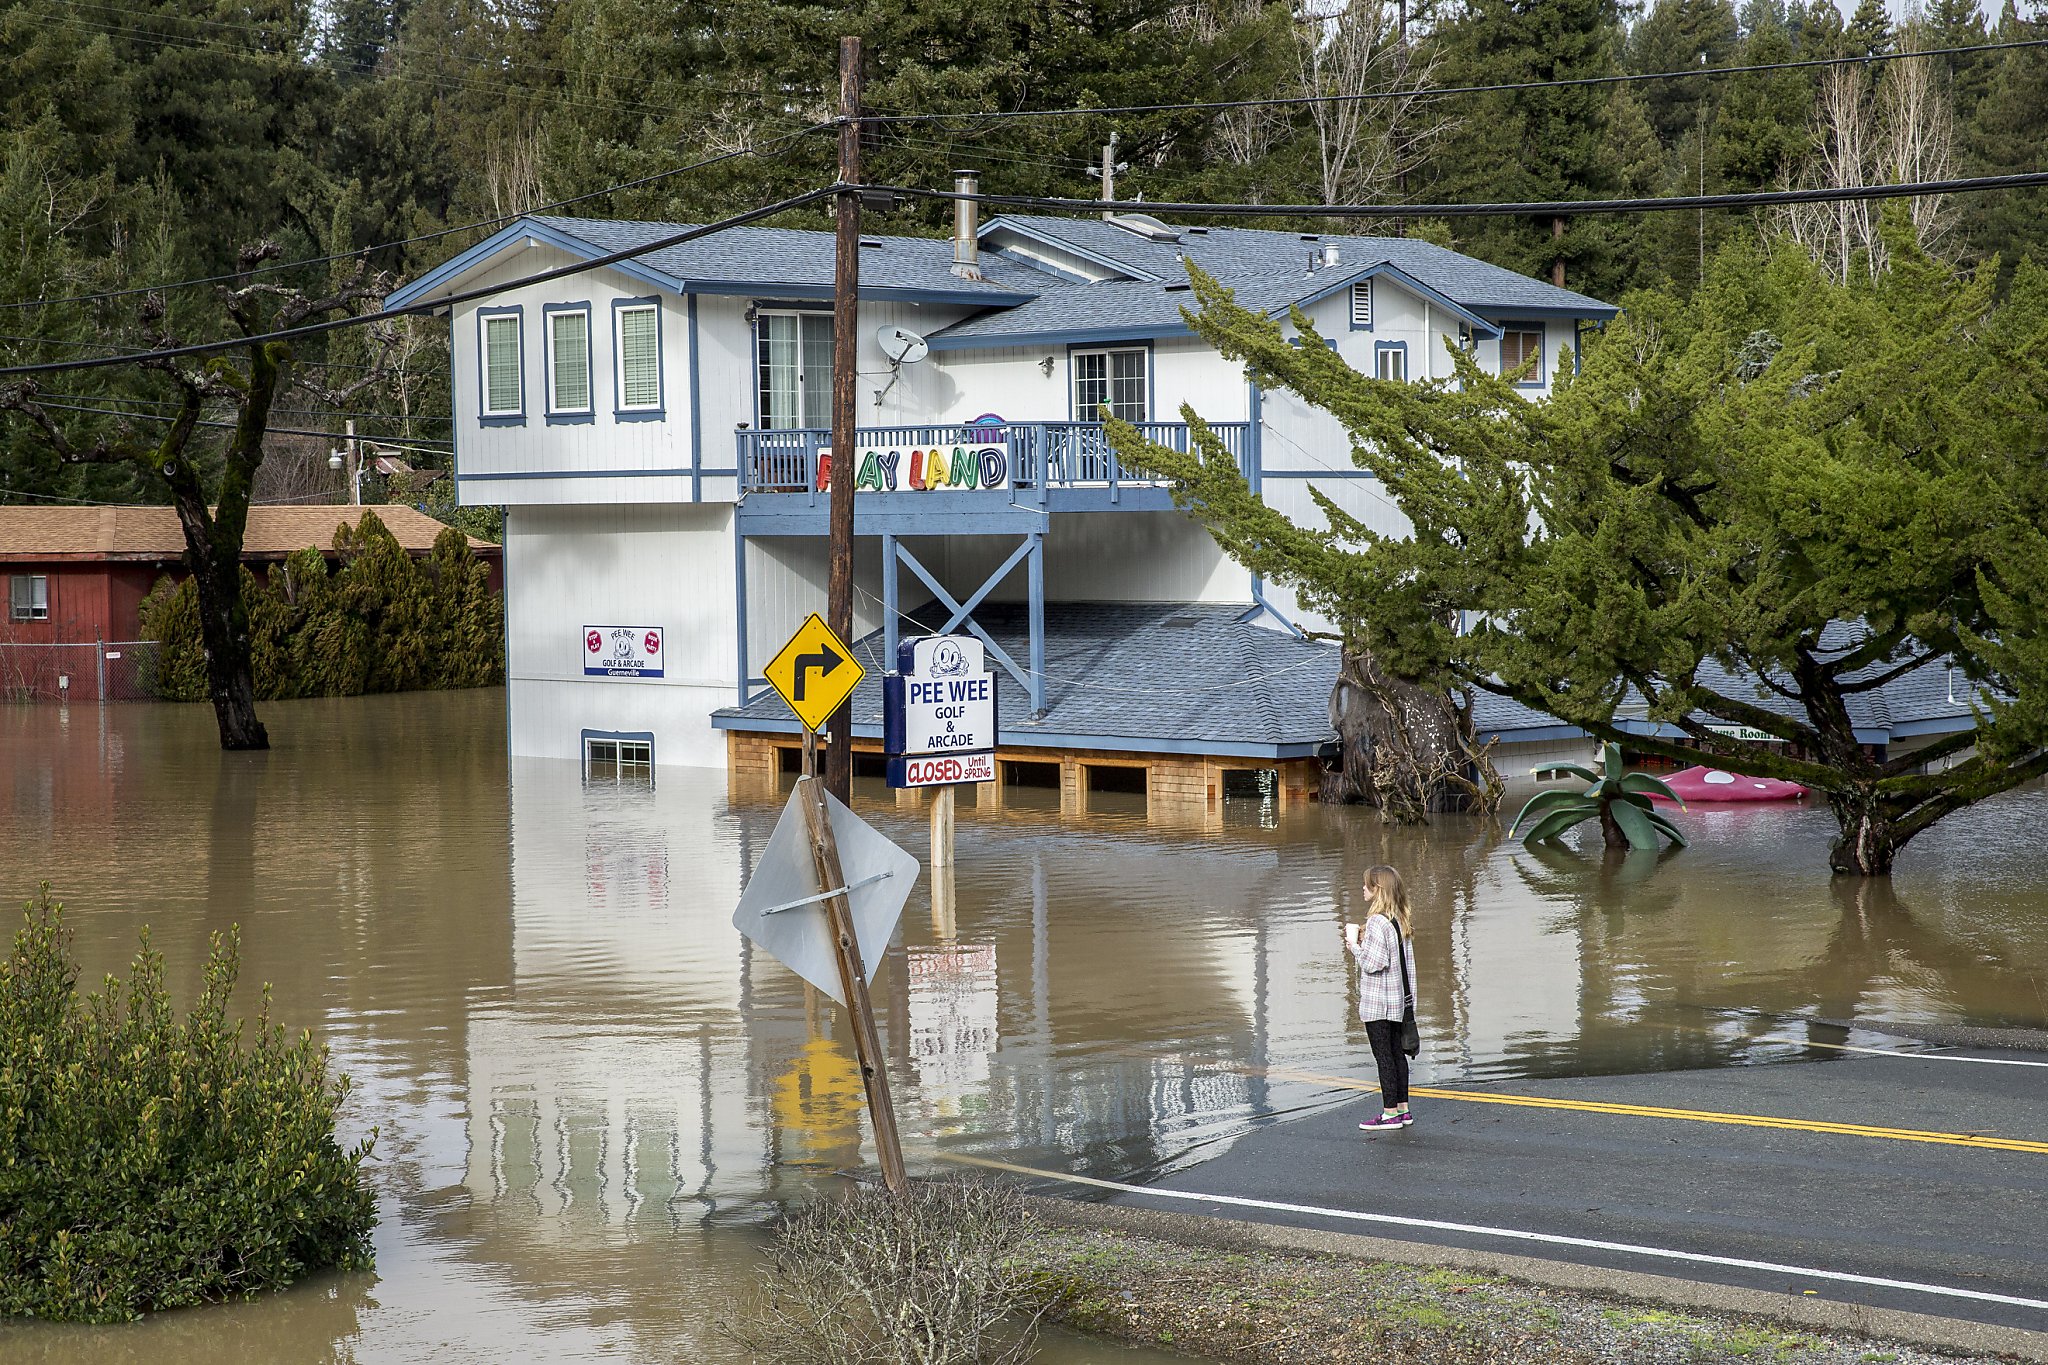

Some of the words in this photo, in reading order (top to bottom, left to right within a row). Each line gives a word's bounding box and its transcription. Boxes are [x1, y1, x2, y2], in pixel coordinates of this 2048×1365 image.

[817, 450, 900, 491] PAY
[909, 447, 1007, 491] LAND
[611, 629, 622, 640] PEE
[622, 629, 636, 640] WEE
[608, 668, 640, 676] Guerneville
[910, 682, 944, 704] PEE
[948, 680, 988, 702] WEE
[936, 706, 965, 719] GOLF
[946, 721, 954, 732] &
[1739, 728, 1771, 739] Room
[928, 734, 974, 748] ARCADE
[968, 756, 986, 767] Until
[908, 759, 962, 783] CLOSED
[964, 767, 991, 779] SPRING
